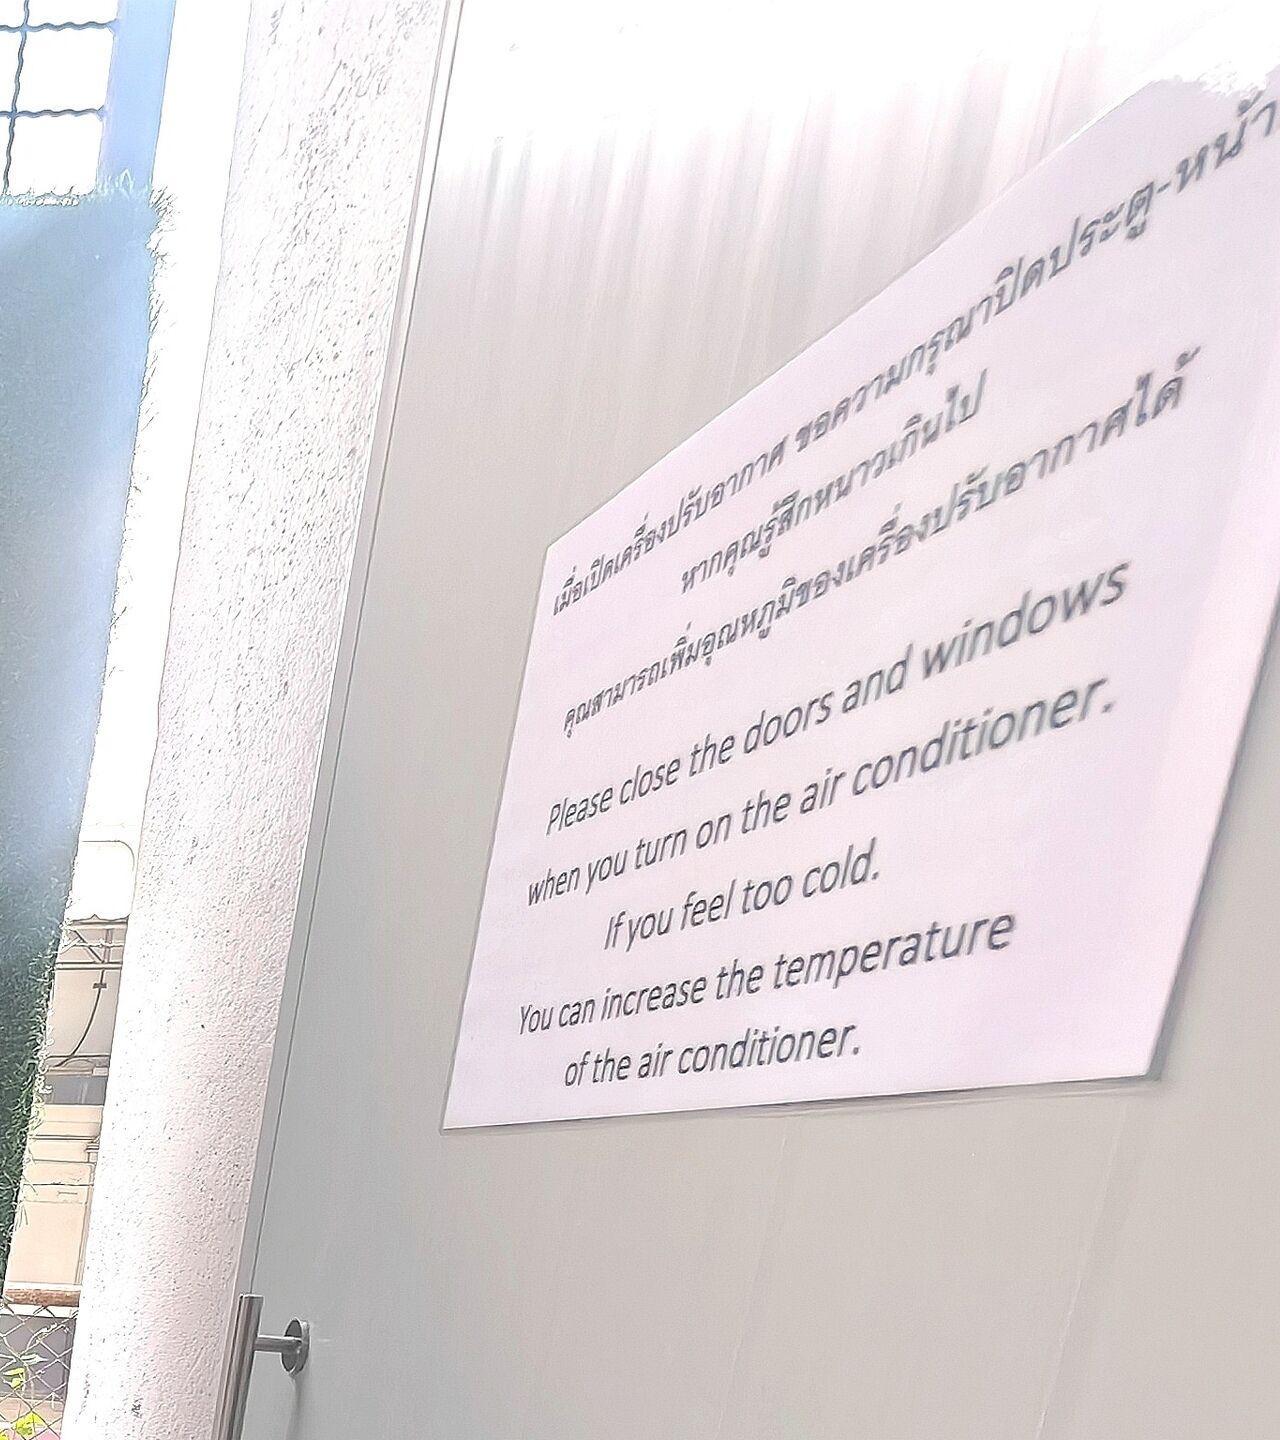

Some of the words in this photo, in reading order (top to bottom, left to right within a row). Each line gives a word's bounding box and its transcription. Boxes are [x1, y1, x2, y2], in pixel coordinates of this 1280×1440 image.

[545, 785, 613, 836] Please
[618, 757, 681, 806] close
[689, 734, 735, 777] the
[743, 690, 835, 755] doors
[841, 642, 914, 714] and
[922, 560, 1132, 680] windows
[527, 867, 581, 907] when
[585, 849, 629, 895] you
[634, 828, 688, 870] turn
[695, 811, 732, 850] on
[741, 789, 792, 835] the
[799, 767, 848, 815] air
[852, 677, 1115, 797] conditioner.
[603, 911, 627, 950] If
[626, 906, 674, 952] you
[680, 878, 737, 931] feel
[741, 873, 794, 915] too
[801, 836, 880, 899] cold.
[518, 1002, 554, 1035] You
[558, 996, 596, 1027] can
[600, 974, 708, 1023] increase
[715, 957, 765, 1001] the
[772, 911, 1018, 989] temperature
[564, 1050, 593, 1087] of
[590, 1049, 632, 1084] the
[636, 1041, 673, 1079] air
[676, 1020, 861, 1076] conditioner.
